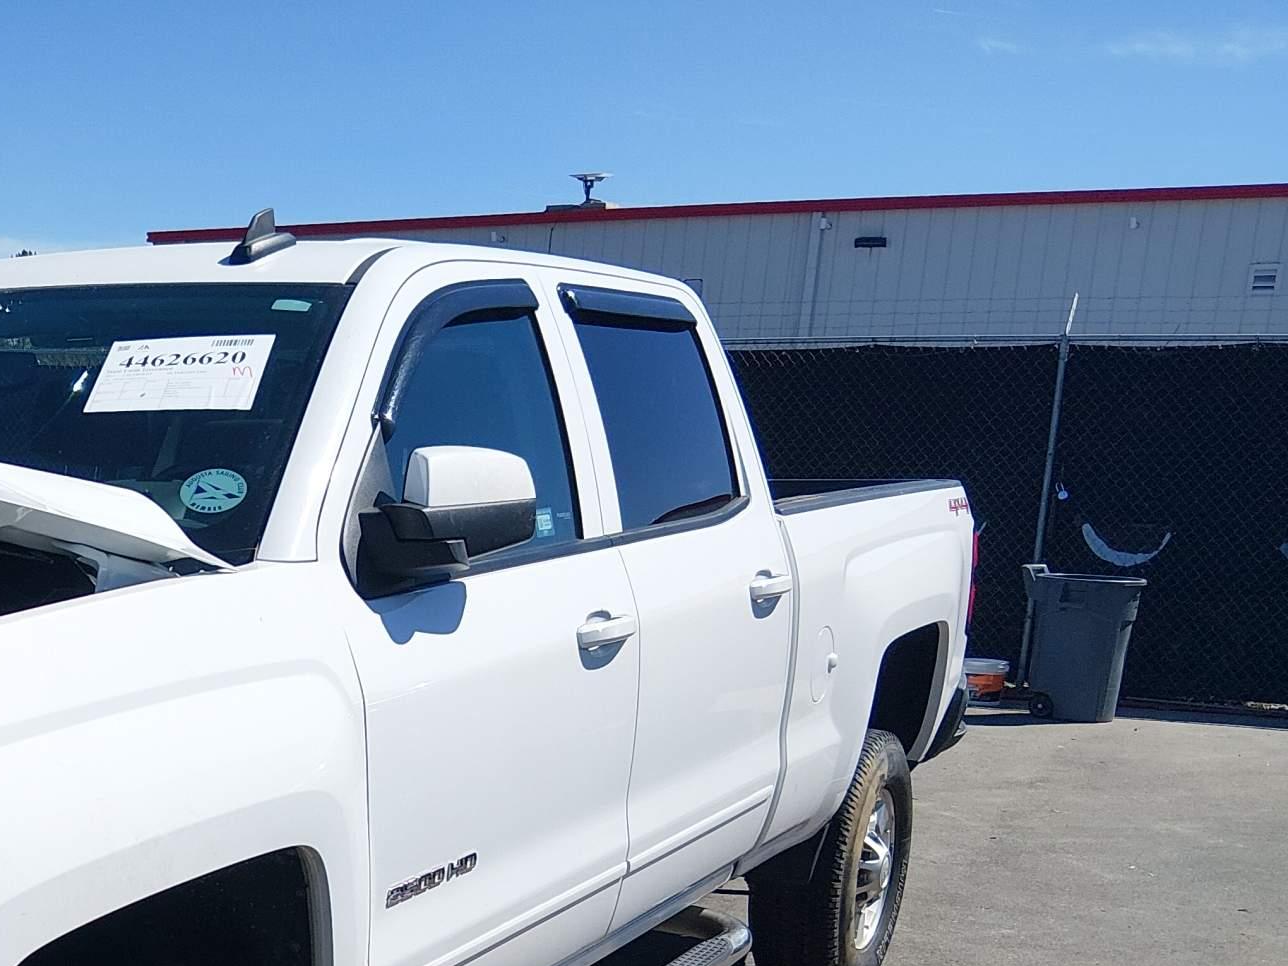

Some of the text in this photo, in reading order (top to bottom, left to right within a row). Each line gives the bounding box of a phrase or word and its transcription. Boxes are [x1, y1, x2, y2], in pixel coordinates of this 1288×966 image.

[119, 351, 247, 369] 44626620
[385, 851, 478, 909] 2500 HD
